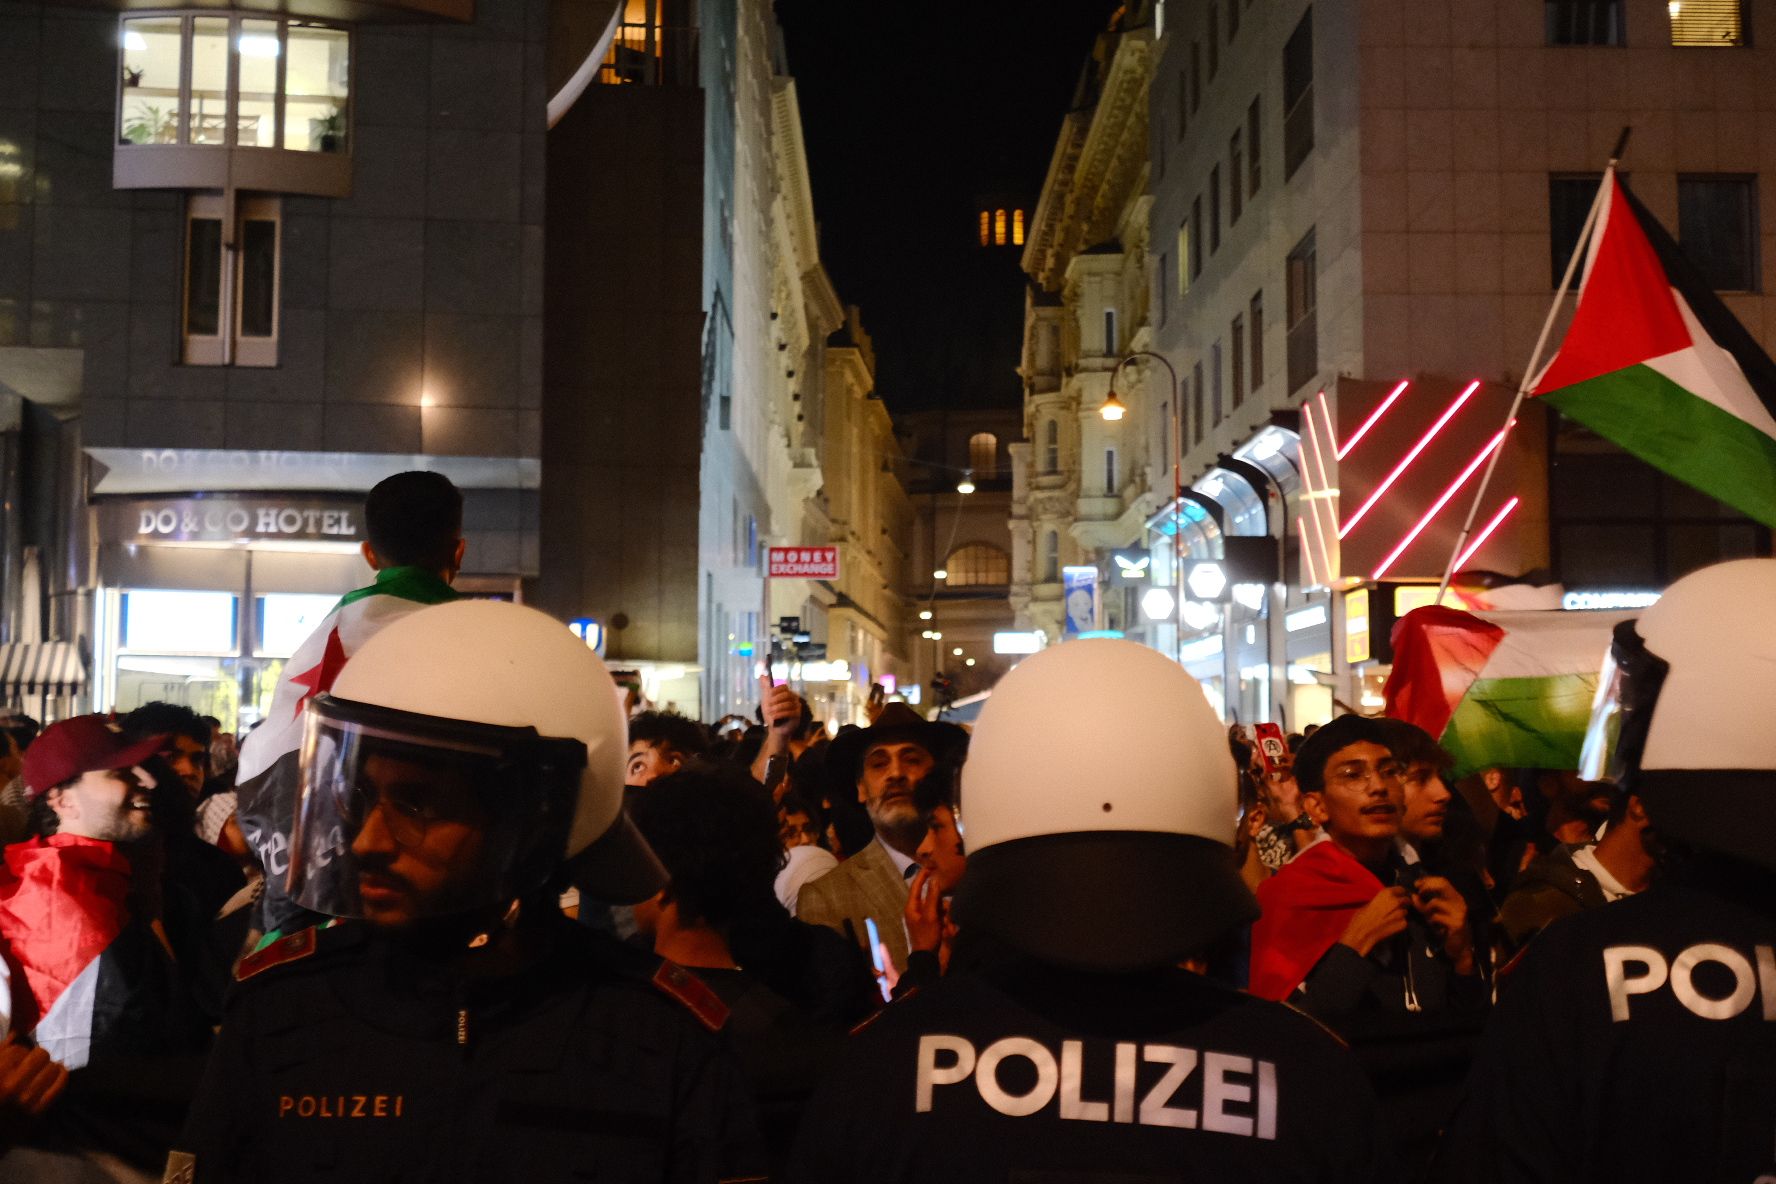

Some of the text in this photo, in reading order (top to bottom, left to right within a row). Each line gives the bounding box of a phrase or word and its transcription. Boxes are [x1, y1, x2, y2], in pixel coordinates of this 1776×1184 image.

[138, 508, 356, 535] DO & CO HOTEL
[771, 550, 835, 563] MONEY
[771, 563, 835, 574] EXCHANGE
[457, 1010, 467, 1044] POLIZEI
[916, 1035, 1277, 1140] POLIZEI
[279, 1096, 403, 1118] POLIZEI
